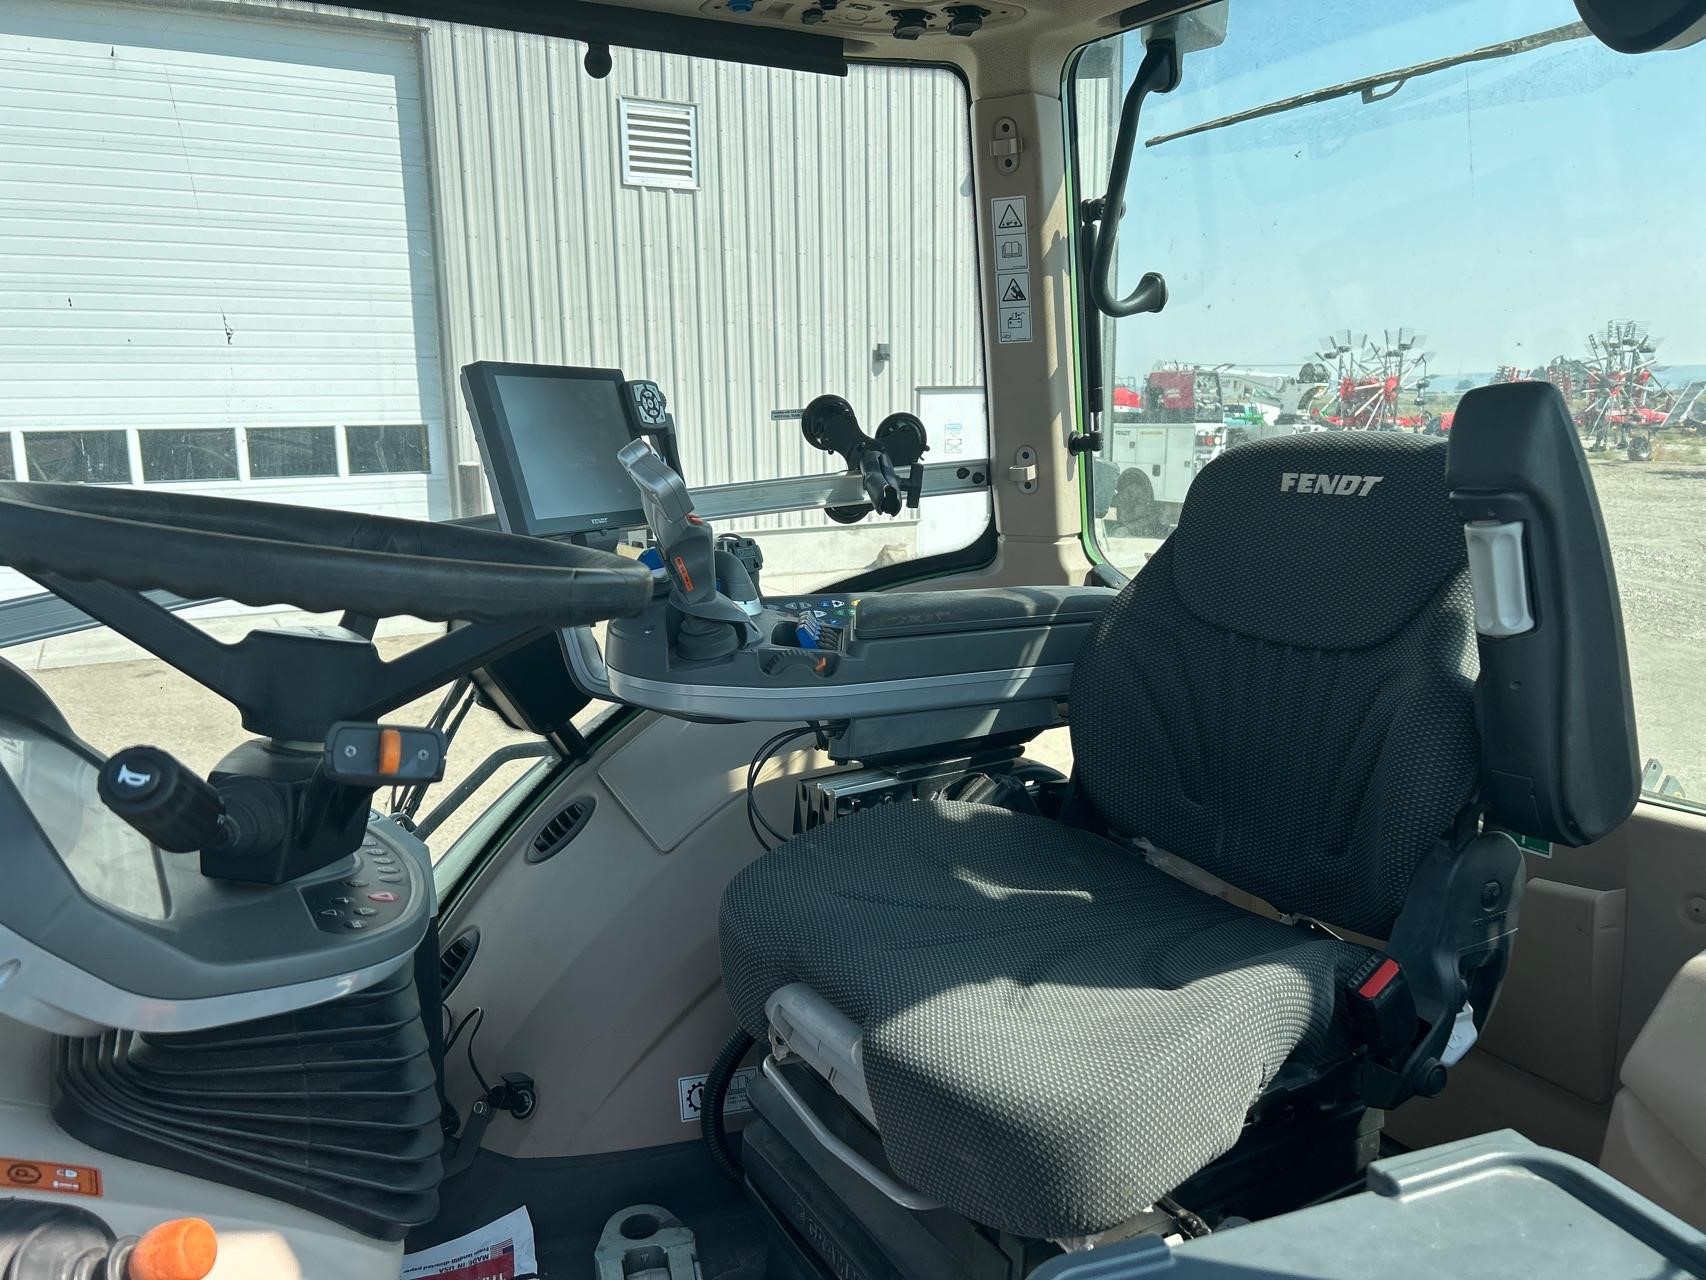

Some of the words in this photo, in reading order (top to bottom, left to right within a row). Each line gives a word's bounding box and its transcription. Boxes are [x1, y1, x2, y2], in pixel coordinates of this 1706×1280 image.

[1280, 472, 1384, 497] FENDT
[468, 1254, 490, 1265] MADE
[439, 1265, 455, 1273] USA
